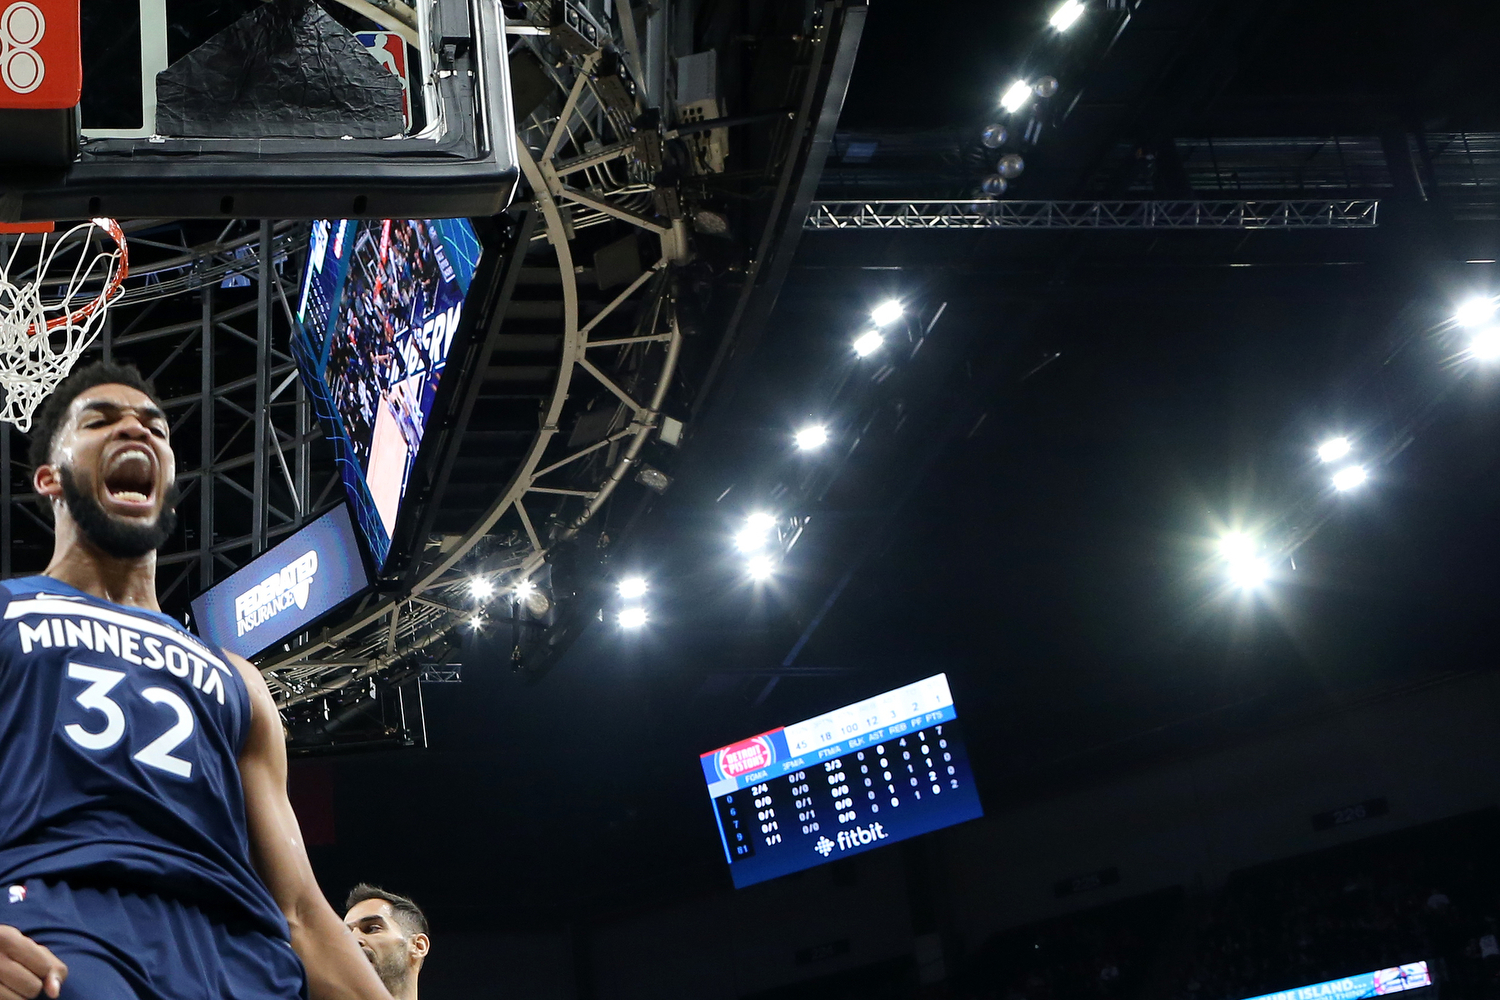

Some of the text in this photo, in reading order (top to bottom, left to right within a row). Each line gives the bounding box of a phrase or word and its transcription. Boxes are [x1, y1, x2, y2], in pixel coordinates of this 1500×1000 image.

[235, 550, 318, 621] FEDERATED
[237, 591, 295, 637] INSURANCE
[18, 618, 225, 705] MINNESOTA
[64, 662, 194, 778] 32
[726, 744, 762, 764] DETROIT
[796, 741, 808, 750] 45
[841, 723, 859, 735] 100
[866, 716, 879, 727] 12
[868, 730, 885, 742] AST
[925, 710, 944, 723] PTS
[728, 756, 765, 775] PISTONS
[751, 783, 769, 796] 2/4
[788, 771, 806, 783] 0/0
[824, 759, 842, 772] 3/3
[857, 751, 865, 761] 0
[876, 744, 885, 755] 0
[899, 738, 907, 747] 4
[918, 731, 926, 741] 1
[935, 725, 942, 735] 7
[754, 739, 947, 808] 0/0 0/0 0/0 0 0 0 0 0
[758, 808, 775, 821] 0/1
[795, 797, 812, 809] 0/1
[831, 785, 849, 798] 0/0
[864, 777, 872, 787] 0
[883, 770, 892, 781] 0
[907, 764, 914, 773] 1
[925, 757, 933, 768] 1
[943, 752, 951, 762] 0
[761, 765, 955, 833] 0/1 0/1 0/0 0 1 0 2 0
[766, 778, 959, 846] 1/1 0/0 0/0 0 0 1 0 2
